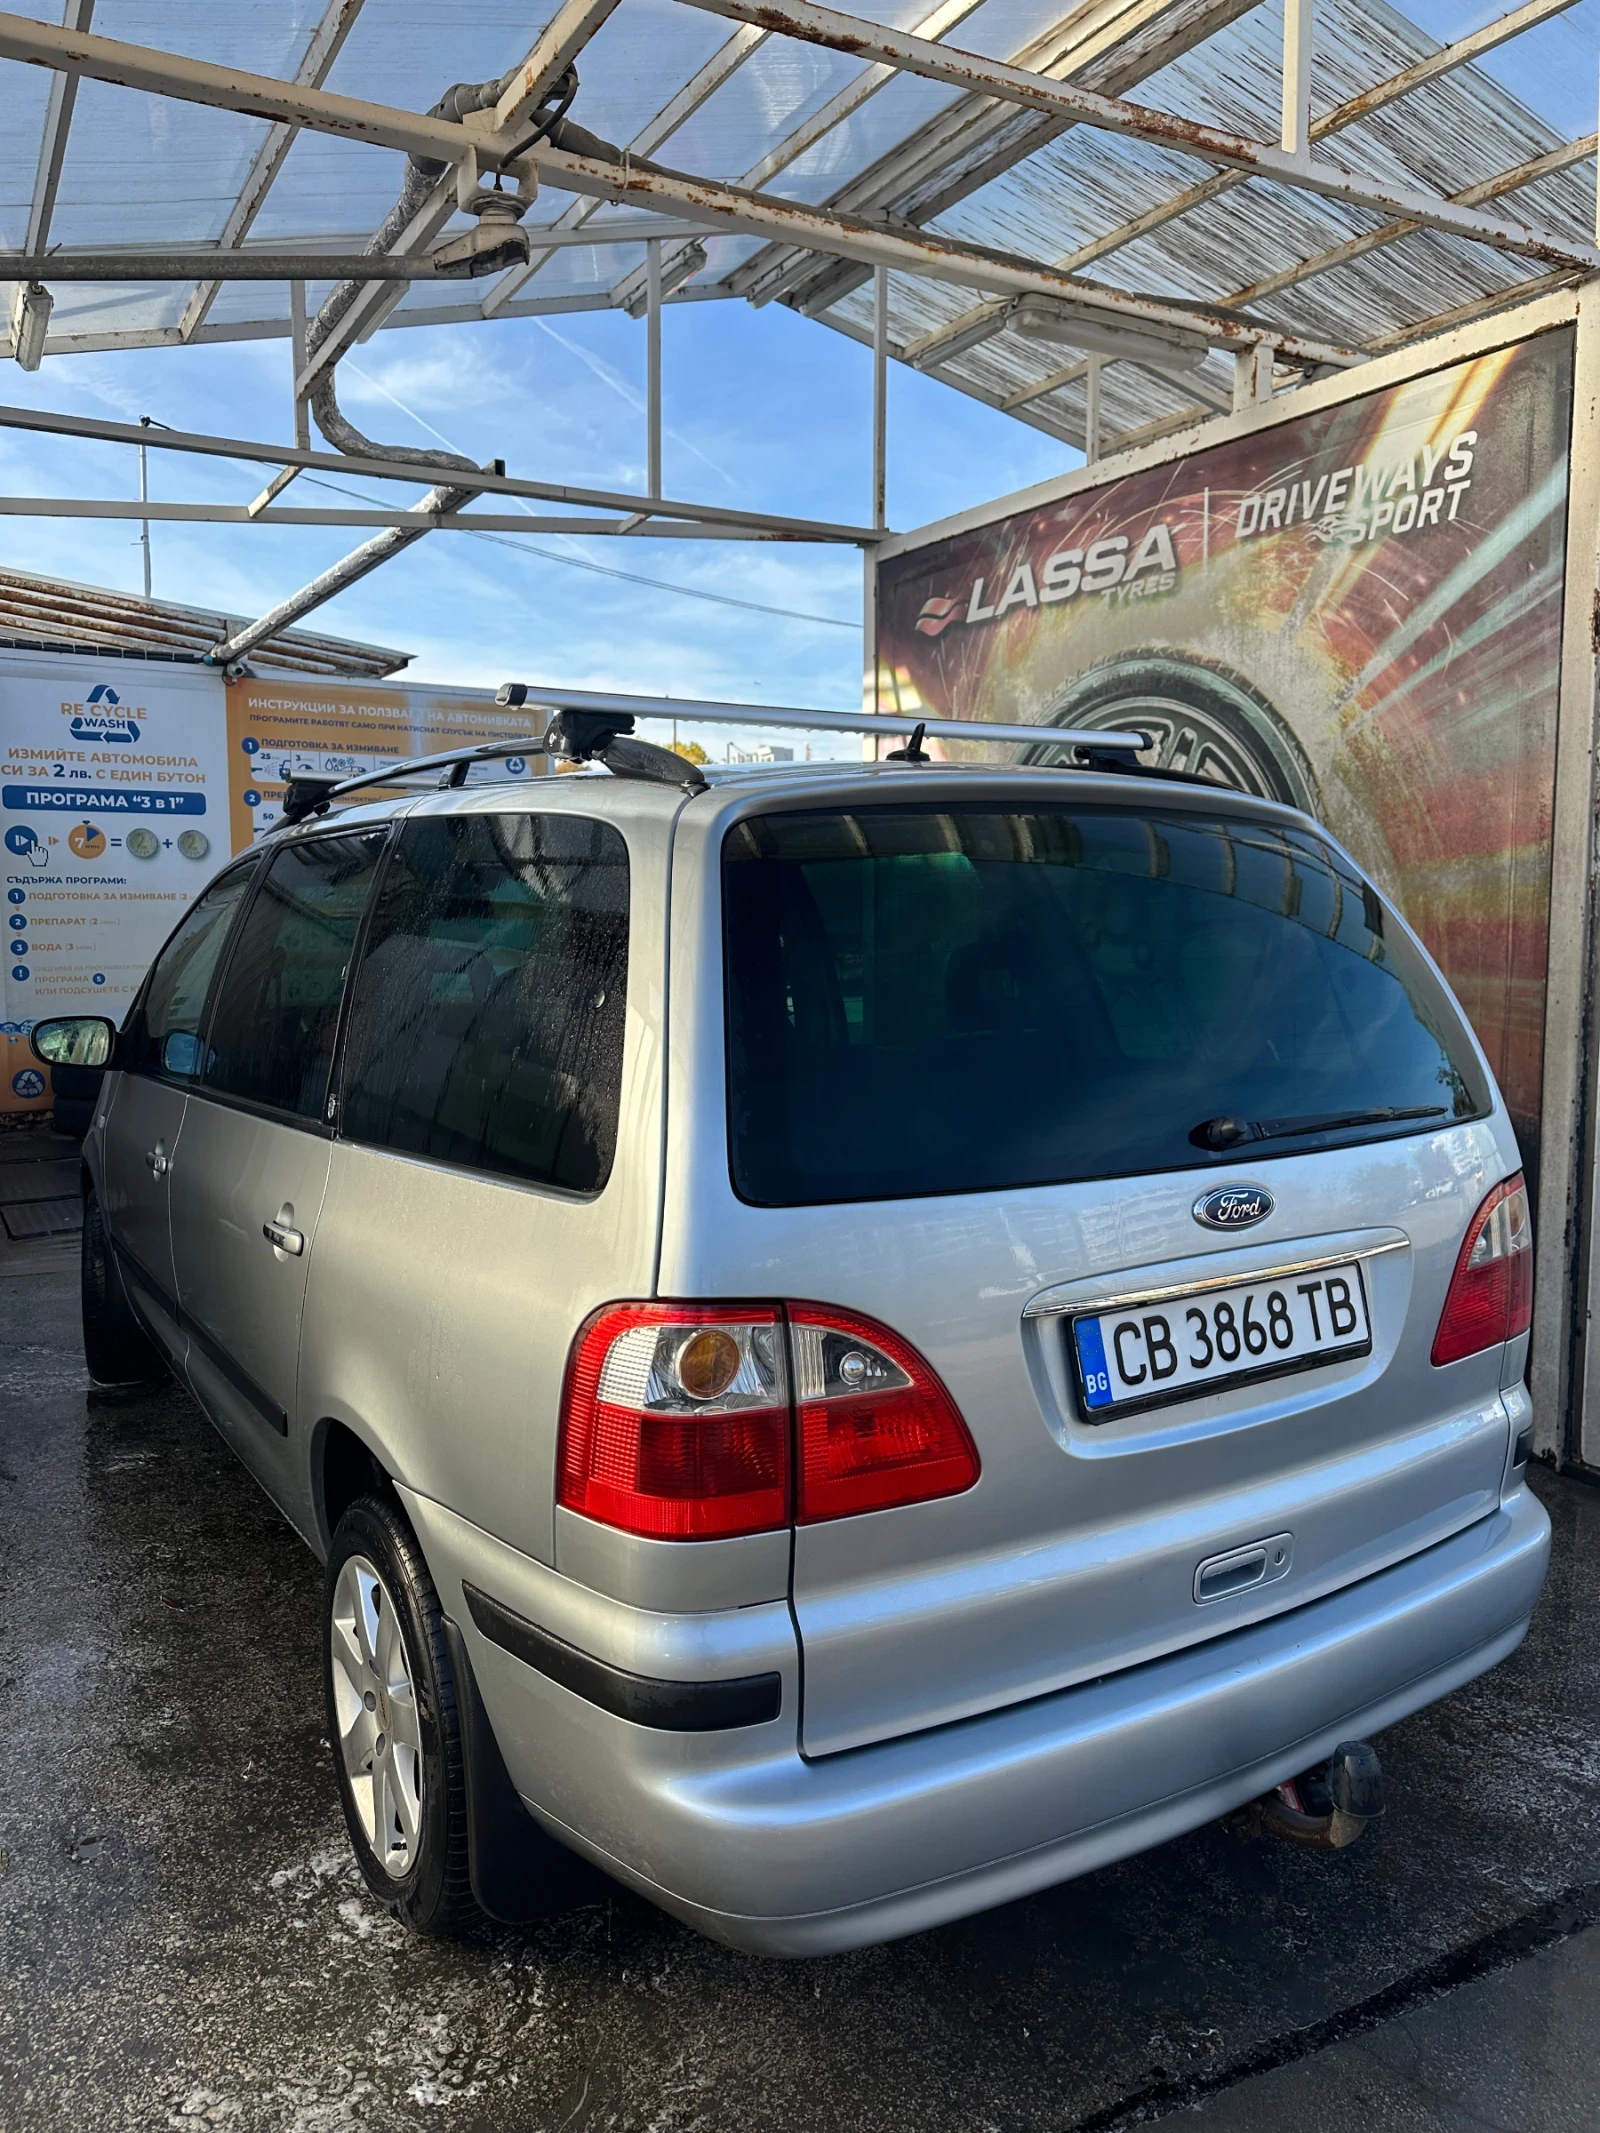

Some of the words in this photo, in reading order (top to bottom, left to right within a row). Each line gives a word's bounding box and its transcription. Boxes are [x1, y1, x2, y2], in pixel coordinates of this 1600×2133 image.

[1234, 430, 1478, 539] DRIVEWAYS
[1349, 479, 1472, 546] SPORT
[966, 524, 1178, 624] LASSA
[1100, 571, 1176, 610] TYRES
[60, 702, 84, 716] RE
[90, 704, 147, 720] CYCLE
[248, 697, 336, 713] ИНСТРУКЦИИ
[339, 705, 355, 715] ЗА
[428, 711, 444, 721] НА
[447, 713, 531, 728] АВТОМИВКАТА
[82, 717, 126, 729] WASH
[250, 714, 308, 725] ПРОГРАМИТЕ
[311, 719, 349, 728] РАБОТЯТ
[351, 722, 376, 730] САМО
[378, 723, 395, 731] ПРИ
[397, 725, 440, 733] НАТИСНАТ
[442, 728, 473, 736] СПУСЪК
[261, 738, 329, 750] ПОДГОТОВКА
[331, 743, 344, 751] ЗА
[346, 744, 399, 754] ИЗМИВАНЕ
[8, 748, 86, 762] ИЗМИЙТЕ
[90, 752, 198, 767] АВТОМОБИЛА
[260, 752, 271, 760] 25
[1, 765, 23, 776] СИ
[28, 766, 49, 777] ЗА
[53, 763, 66, 778] 2
[69, 768, 92, 779] лв.
[96, 769, 106, 780] С
[110, 769, 152, 782] ЕДИН
[157, 771, 206, 783] БУТОН
[26, 791, 129, 808] ПРОГРАМА
[75, 837, 85, 849] 7
[7, 876, 63, 886] СЪДЪРЖА
[65, 876, 127, 885] ПРОГРАМИ:
[28, 892, 101, 901] ПОДГОТОВКА
[30, 917, 87, 926] ПРЕПАРАТ
[31, 943, 62, 952] ВОДА
[60, 986, 119, 995] ПОДСУШЕТЕ
[1218, 1192, 1262, 1221] Ford
[1113, 1315, 1178, 1386] CB
[1186, 1290, 1293, 1369] 3868
[1297, 1278, 1357, 1341] TB
[1085, 1372, 1108, 1395] BG
